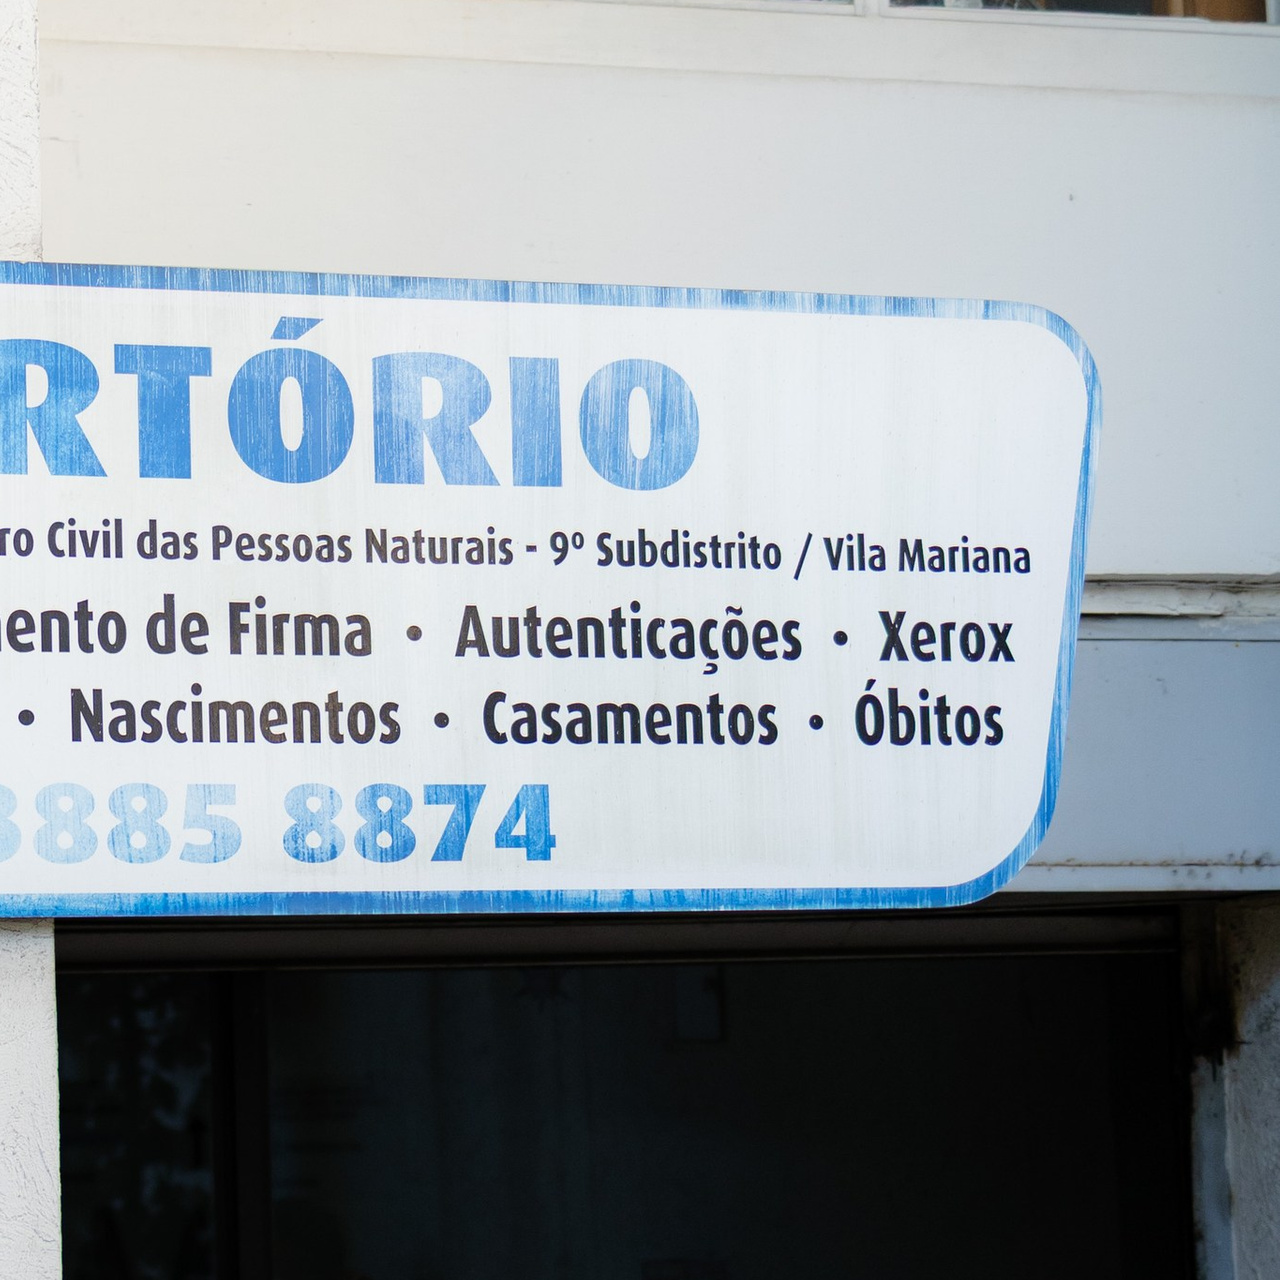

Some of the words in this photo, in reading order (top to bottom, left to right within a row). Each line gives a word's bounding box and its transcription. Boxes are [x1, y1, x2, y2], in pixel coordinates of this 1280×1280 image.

[47, 517, 123, 559] Civil
[136, 519, 199, 560] das
[212, 525, 352, 563] Pessoas
[365, 526, 514, 566] Naturais
[550, 531, 585, 566] 9º
[596, 528, 782, 570] Subdistrito
[823, 533, 886, 572] Vila
[898, 535, 1031, 574] Mariana
[146, 593, 209, 655] de
[228, 595, 372, 657] Firma
[454, 600, 802, 675] Autenticações
[878, 610, 1016, 663] Xerox
[70, 682, 401, 745] Nascimentos
[483, 691, 779, 746] Casamentos
[855, 678, 1004, 746] Óbitos
[282, 782, 558, 865] 8874
